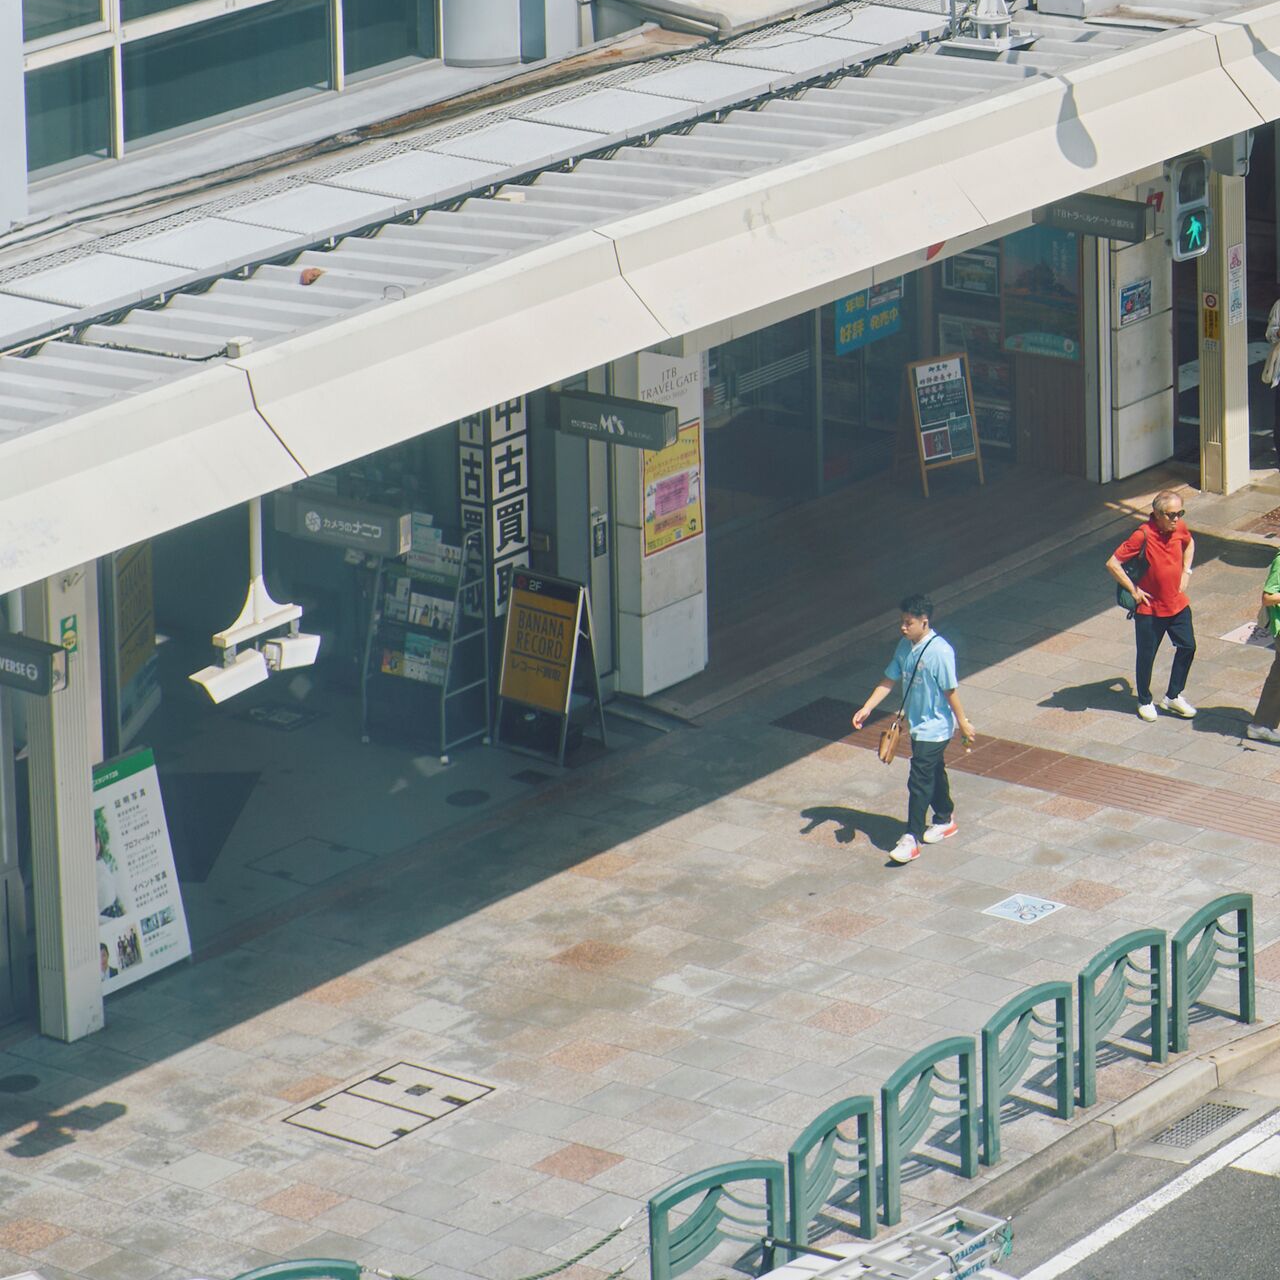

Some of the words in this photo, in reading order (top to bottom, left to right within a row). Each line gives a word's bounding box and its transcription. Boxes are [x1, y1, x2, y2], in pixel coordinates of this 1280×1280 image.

[661, 366, 677, 382] JTB
[640, 379, 675, 401] TRAVEL
[676, 370, 699, 388] GATE
[323, 518, 382, 538] カメラのナニワ
[529, 579, 543, 592] 2F
[518, 609, 565, 639] BANANA
[515, 630, 563, 660] RECORD
[114, 788, 147, 810] 証明写真
